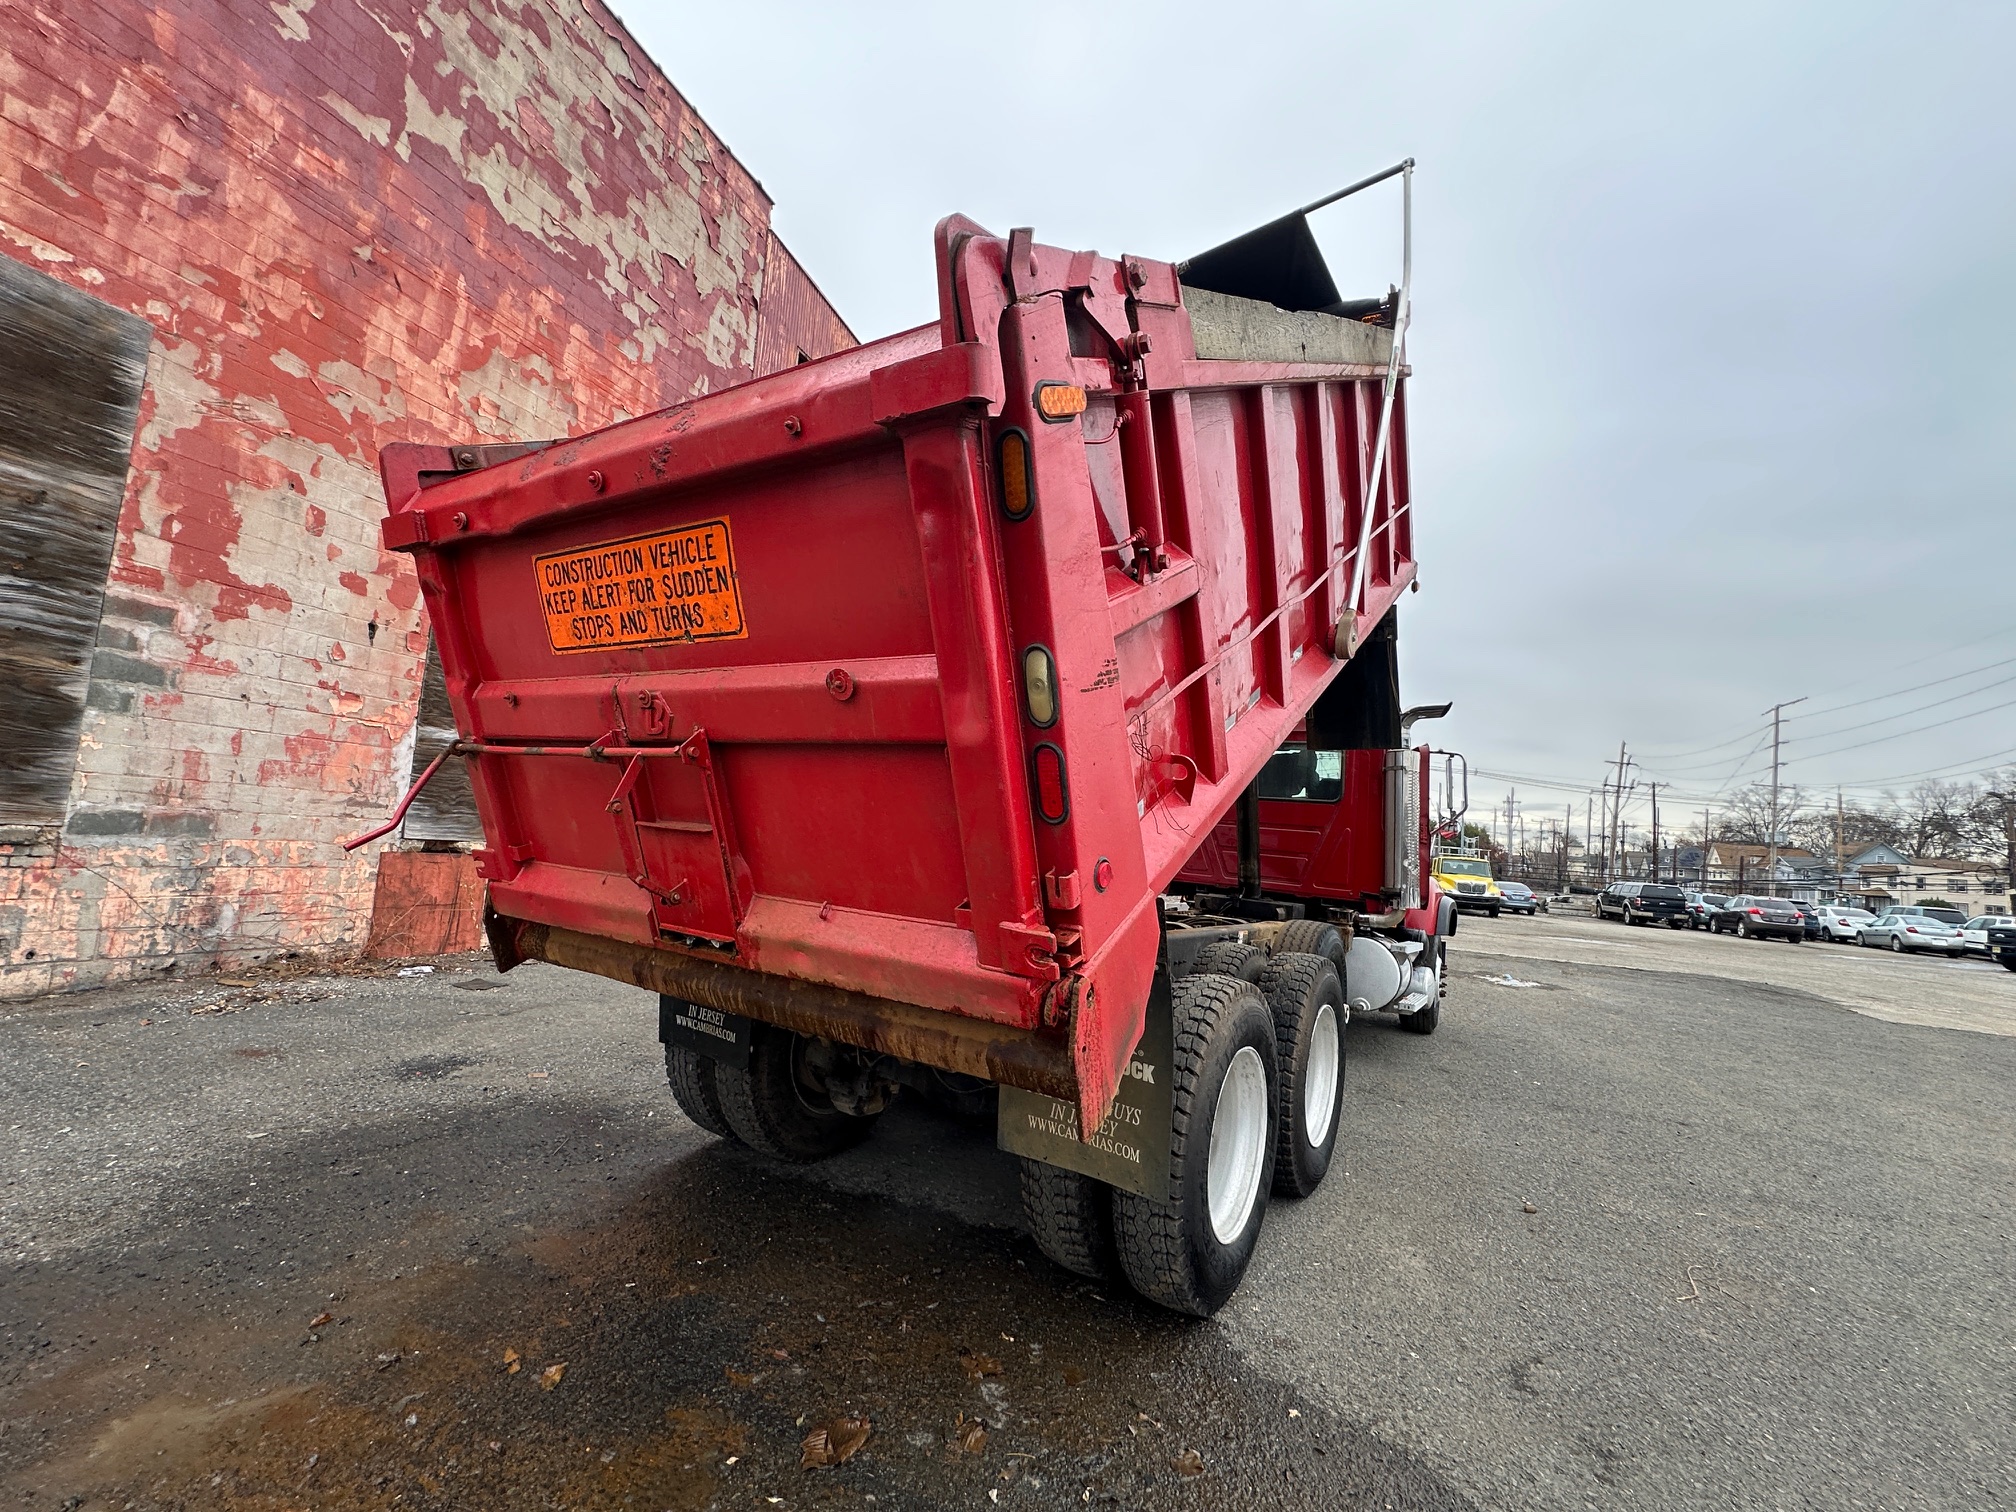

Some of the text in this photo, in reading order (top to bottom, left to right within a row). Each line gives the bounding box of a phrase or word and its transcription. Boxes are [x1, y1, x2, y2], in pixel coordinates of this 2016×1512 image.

[545, 533, 717, 588] CONSTRUCTION VEHICLE
[545, 566, 730, 615] KEEP ALERT FOR SUDDEN
[572, 602, 705, 641] STOPS AND TURNS
[676, 1014, 736, 1044] WWW.CAMBRIAS.COM
[688, 1004, 698, 1018] IN
[697, 1007, 726, 1027] JERSEY
[1050, 1102, 1066, 1121] IN
[1108, 1101, 1142, 1126] UYS
[1028, 1114, 1140, 1163] WWW.CAMRIAS.COM
